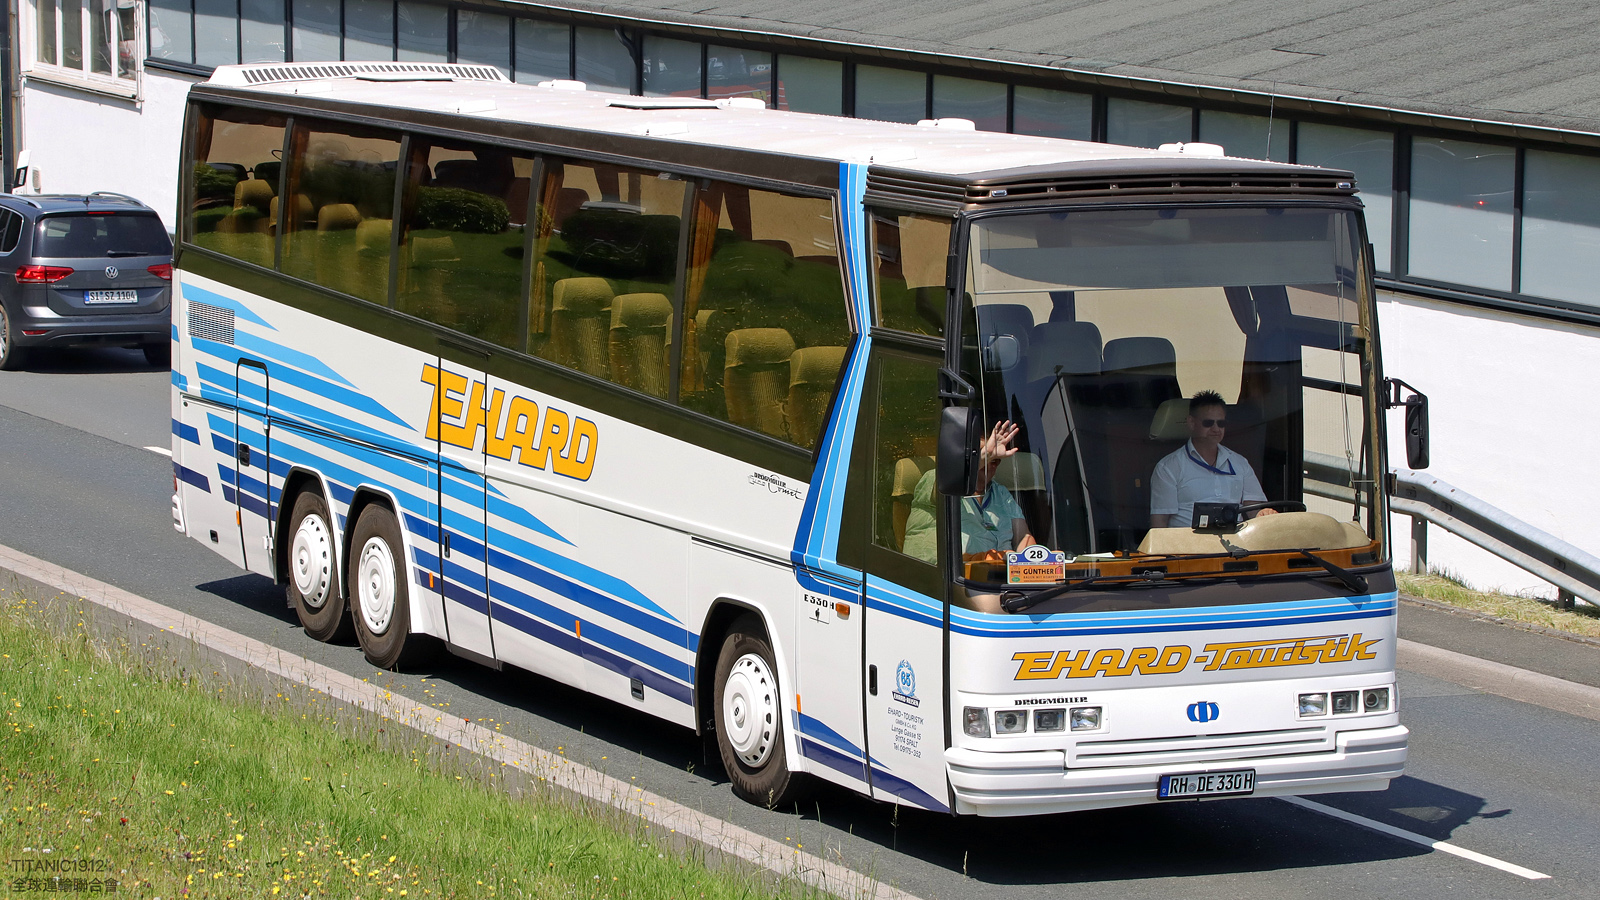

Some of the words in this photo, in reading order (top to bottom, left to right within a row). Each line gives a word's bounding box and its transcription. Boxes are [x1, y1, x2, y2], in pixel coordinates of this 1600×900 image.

[90, 292, 99, 300] SI
[105, 292, 114, 300] SZ
[117, 291, 136, 300] 1104
[420, 362, 598, 482] EHARD
[1029, 550, 1043, 559] 28
[1023, 566, 1054, 575] GÜNTHER
[900, 670, 911, 686] 65
[891, 724, 903, 735] Lange
[904, 728, 916, 739] Gasse
[906, 738, 918, 748] SPALT
[1170, 778, 1188, 794] RH
[1197, 776, 1214, 792] DE
